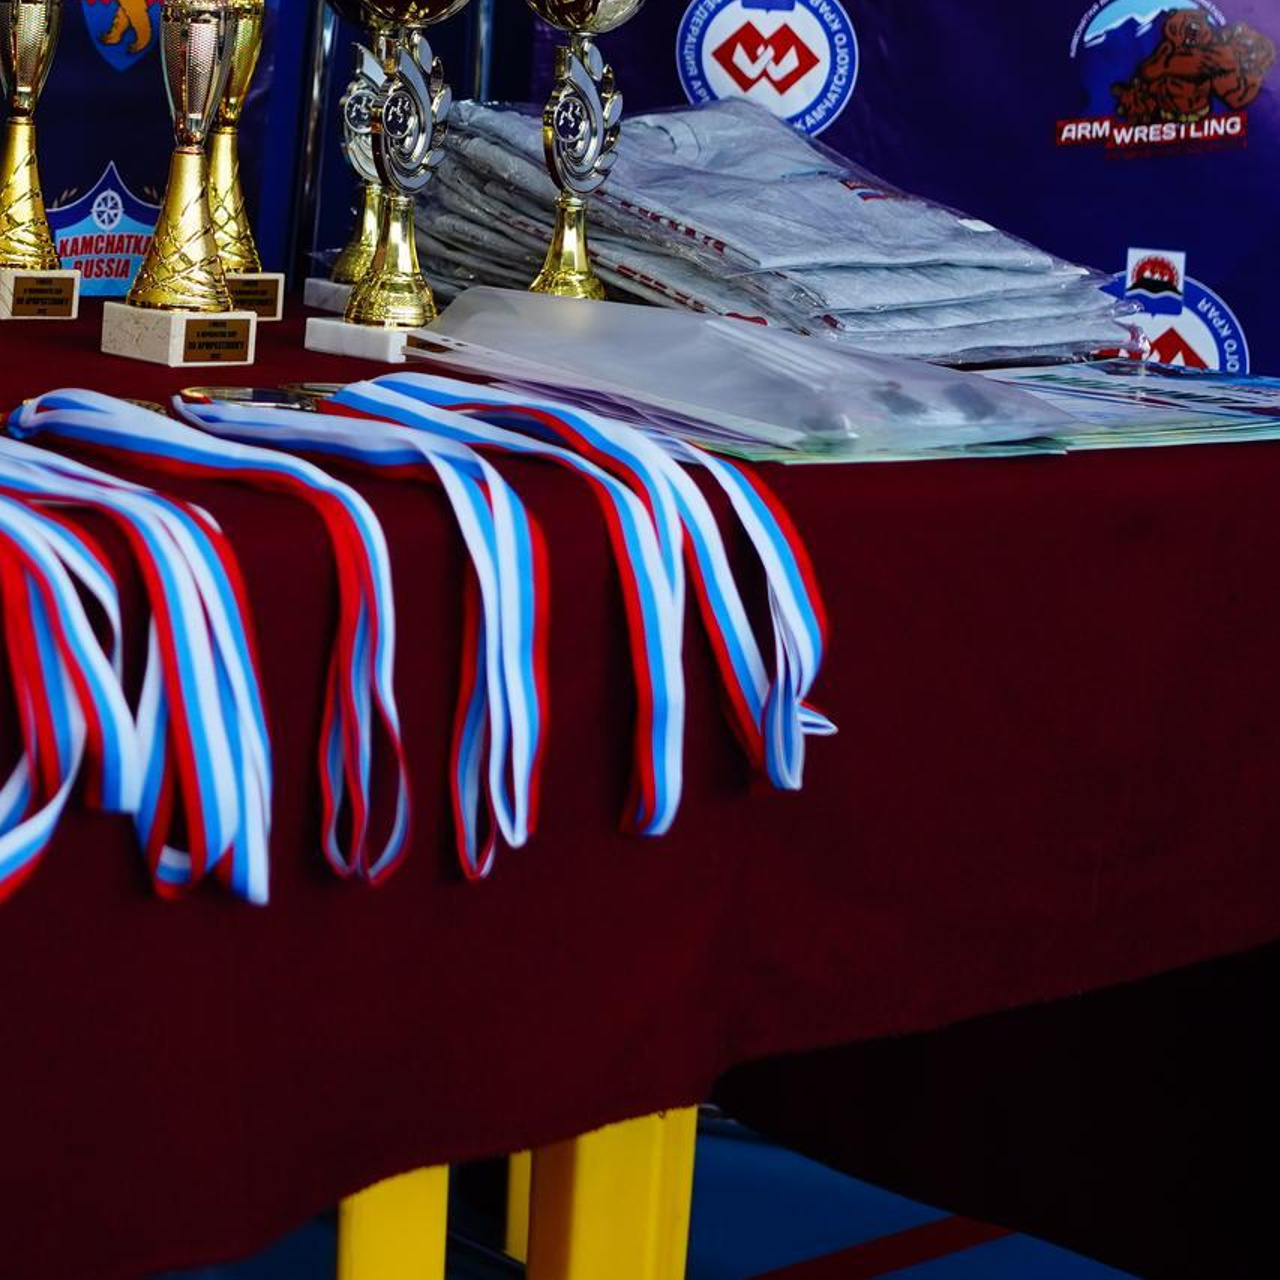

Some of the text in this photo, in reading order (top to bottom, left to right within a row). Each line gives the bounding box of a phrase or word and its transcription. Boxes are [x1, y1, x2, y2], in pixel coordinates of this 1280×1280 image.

[1060, 116, 1242, 146] ARM WRESTLING
[1196, 297, 1232, 338] КРАЯ
